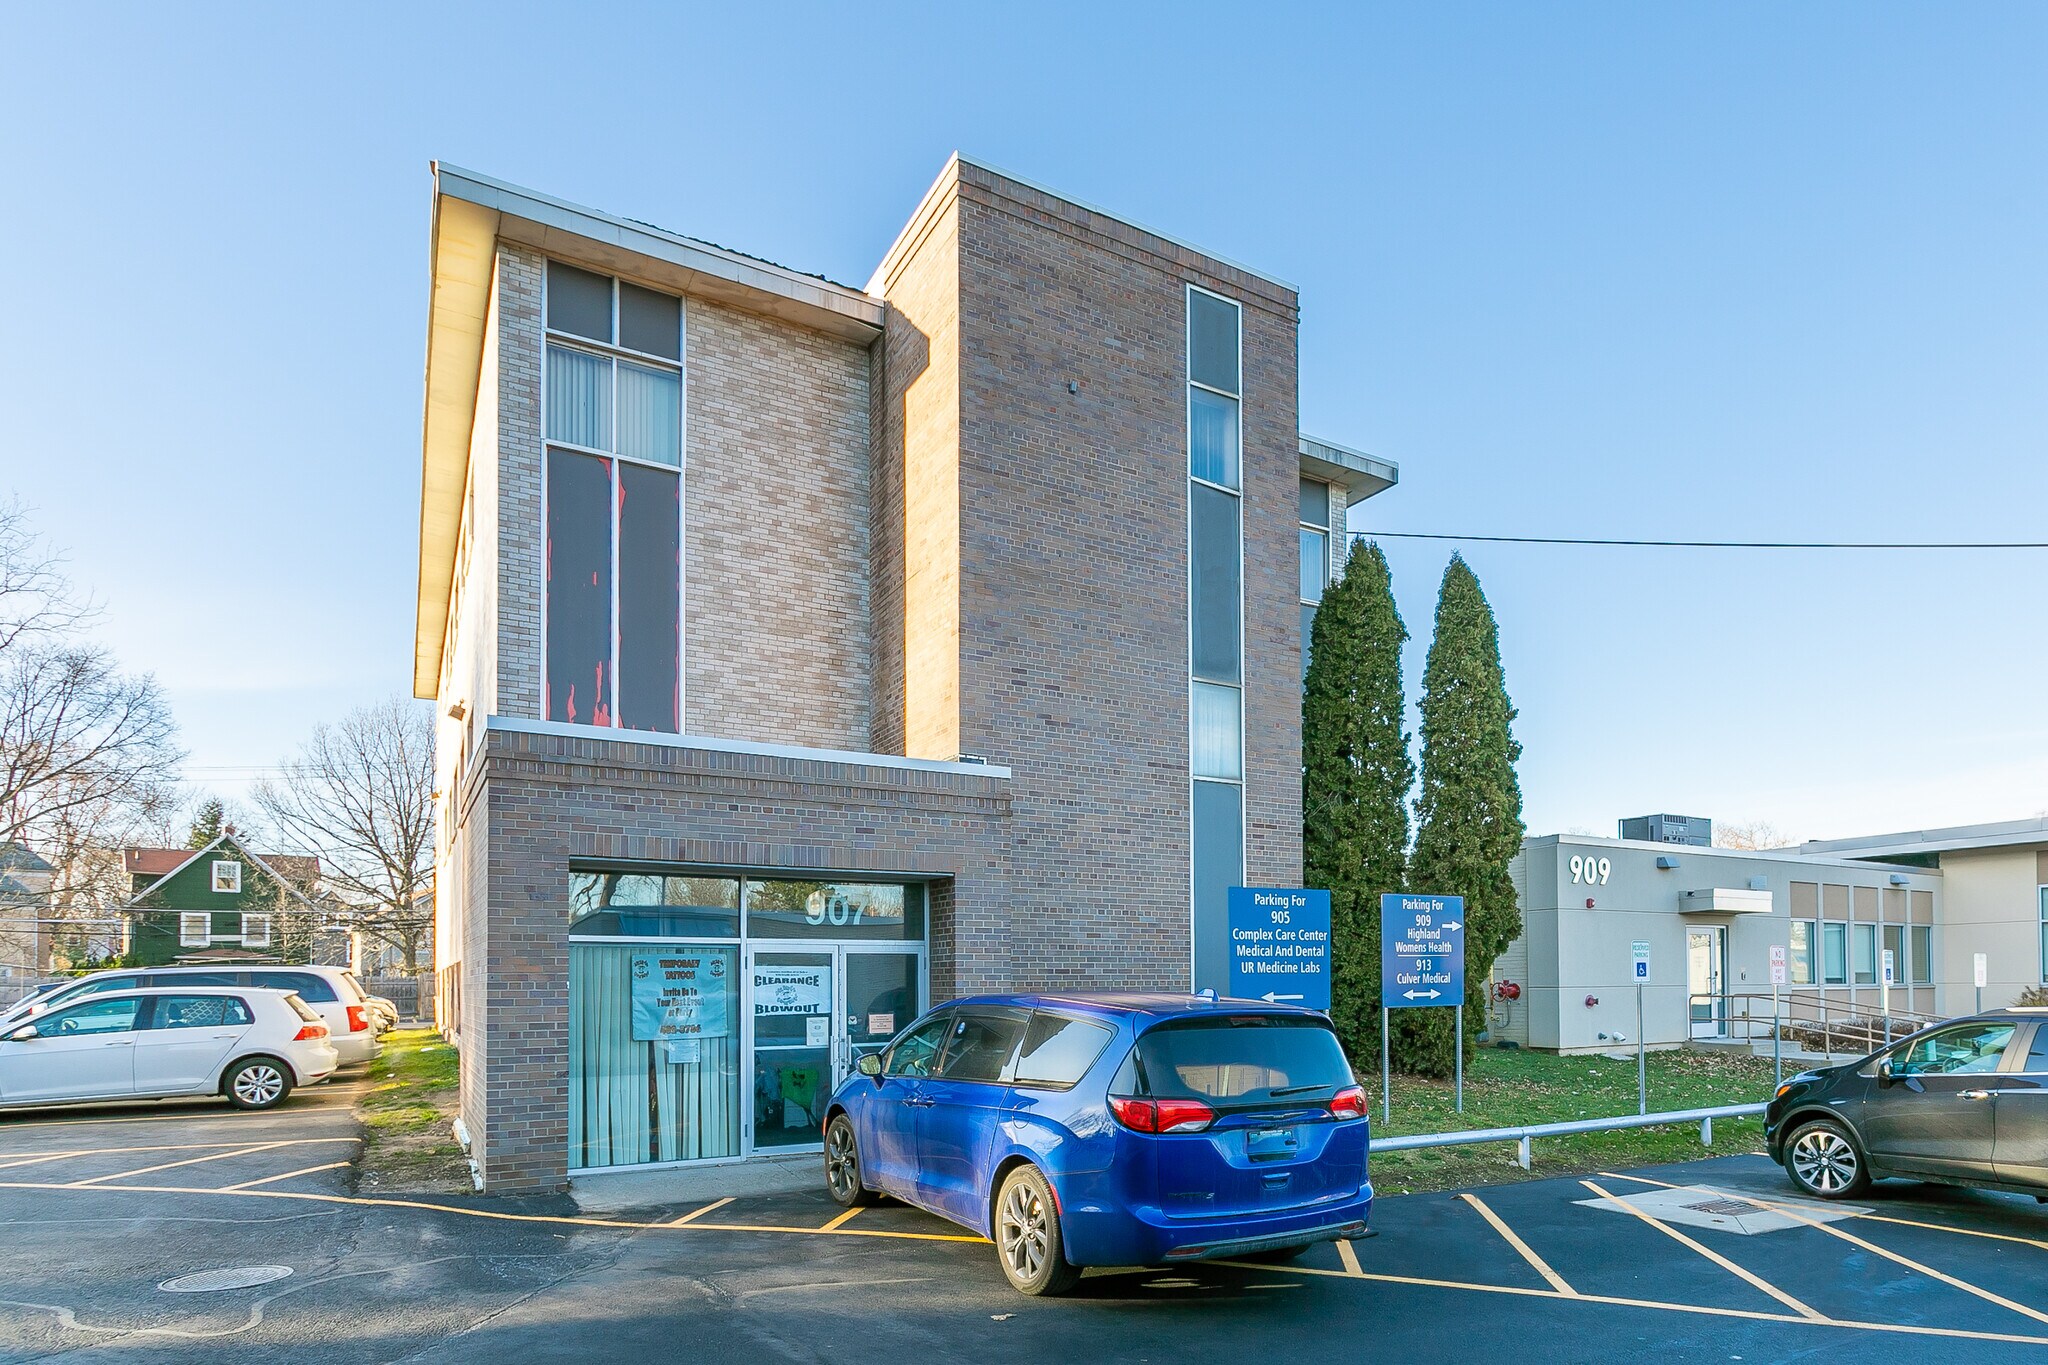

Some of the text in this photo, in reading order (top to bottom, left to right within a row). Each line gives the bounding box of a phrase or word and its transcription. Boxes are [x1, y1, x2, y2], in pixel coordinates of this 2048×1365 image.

[1569, 855, 1611, 886] 909
[1254, 893, 1306, 908] Parking For
[1402, 898, 1444, 913] Parking For
[804, 890, 869, 925] 907
[1271, 910, 1291, 924] 905
[1415, 914, 1432, 927] 909
[1232, 928, 1328, 943] Complex Care Center
[1407, 928, 1441, 942] Highland
[1236, 945, 1325, 957] Medical And Dental
[1395, 941, 1453, 953] Womens Health
[1241, 961, 1321, 974] UR Medicine Labs
[1415, 959, 1432, 971] 913
[664, 971, 696, 981] TATTOOS
[754, 974, 820, 987] CLEARANCE
[1397, 972, 1451, 985] Culver Medical
[755, 1003, 820, 1015] BLOWOUT
